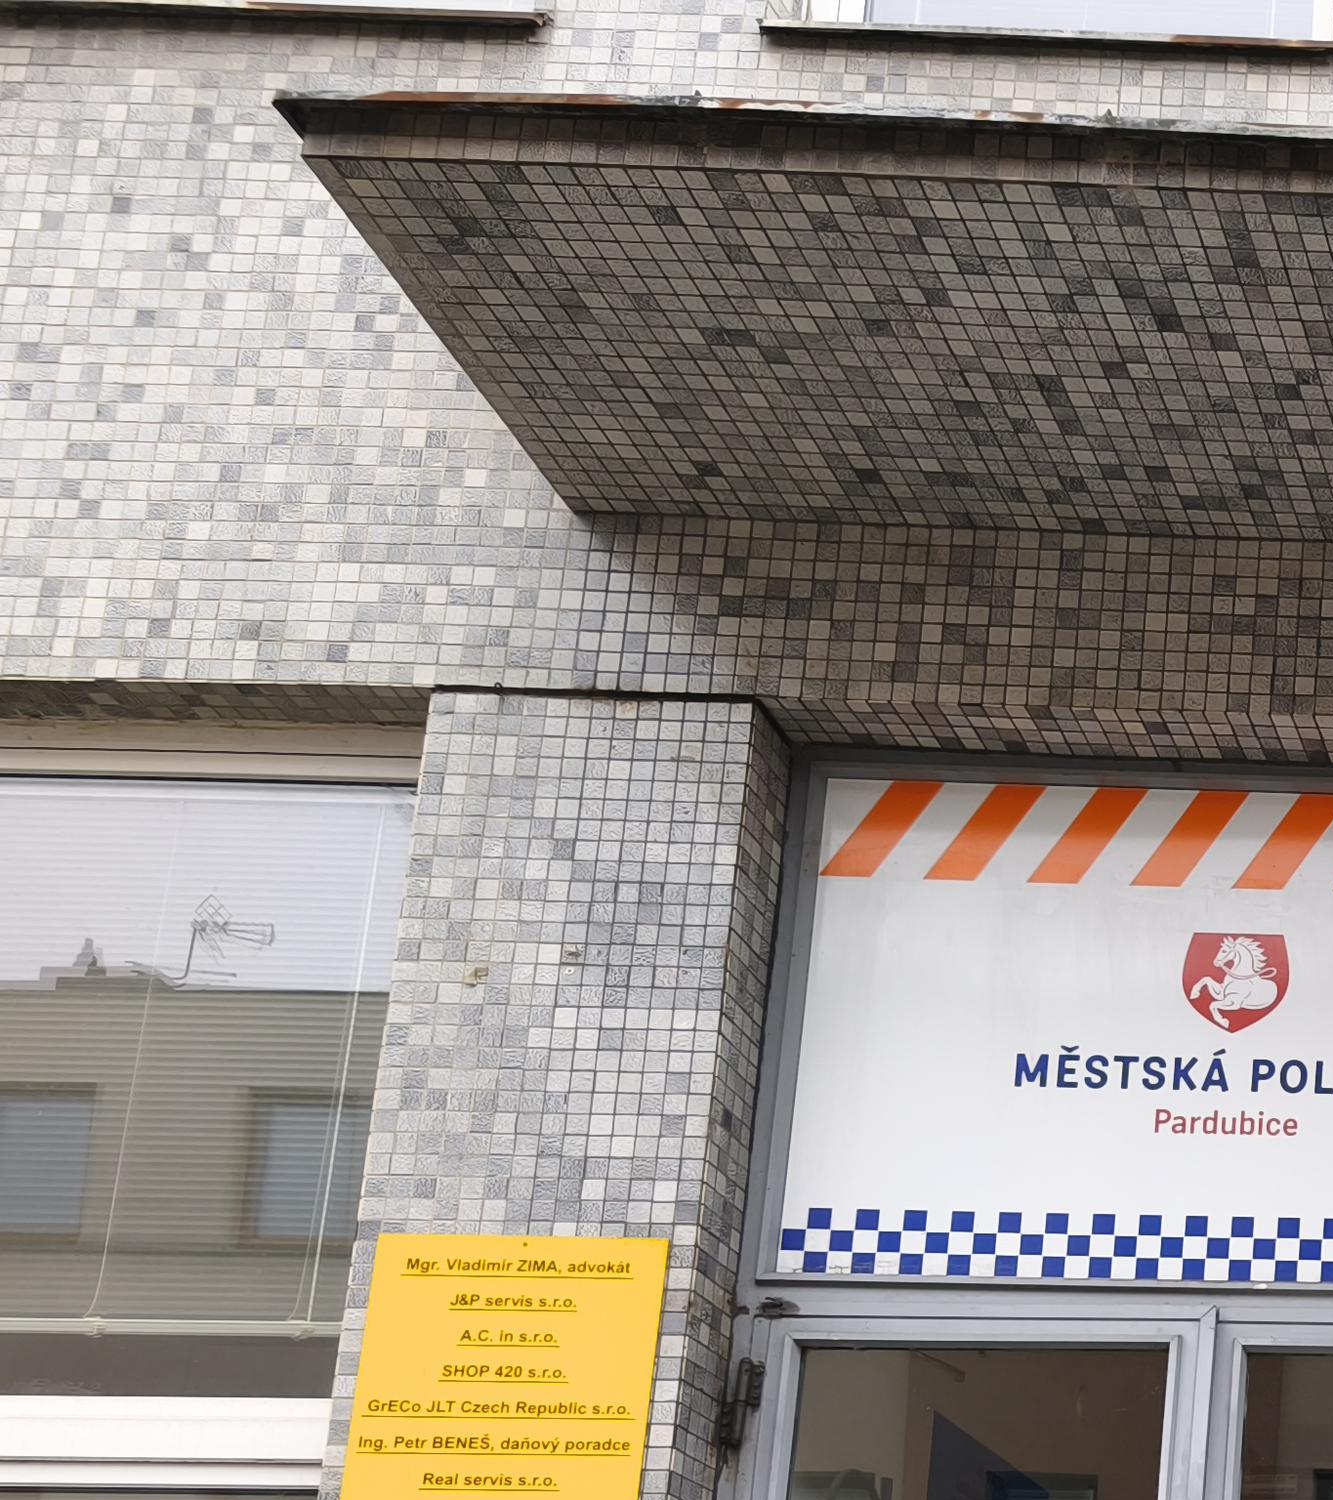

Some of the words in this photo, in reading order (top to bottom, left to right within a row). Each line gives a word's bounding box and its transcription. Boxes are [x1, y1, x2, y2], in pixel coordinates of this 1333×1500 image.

[1014, 1045, 1229, 1092] MĚSTSKÁ
[1154, 1108, 1299, 1136] Pardubice
[406, 1258, 440, 1275] Mgr.
[447, 1258, 513, 1273] Vladimír
[516, 1259, 562, 1275] ZIMA,
[567, 1261, 631, 1274] advokát
[450, 1294, 480, 1307] J&P
[485, 1295, 533, 1308] servis
[538, 1297, 577, 1308] s.r.o.
[459, 1329, 493, 1343] A.C.
[499, 1330, 514, 1343] in
[518, 1332, 558, 1343] s.r.o.
[442, 1364, 490, 1379] SHOP
[494, 1365, 522, 1379] 420
[527, 1367, 566, 1379] s.r.o.
[367, 1399, 421, 1414] GrECo
[426, 1400, 456, 1414] JLT
[460, 1400, 510, 1415] Czech
[515, 1401, 587, 1417] Republic
[592, 1403, 631, 1415] s.r.o.
[358, 1435, 387, 1452] Ing.
[393, 1436, 427, 1450] Petr
[432, 1434, 495, 1452] BENEŠ,
[500, 1437, 559, 1453] daňový
[564, 1438, 631, 1455] poradce
[422, 1473, 458, 1486] Real
[463, 1473, 512, 1487] servis
[517, 1476, 557, 1487] s.r.o.
